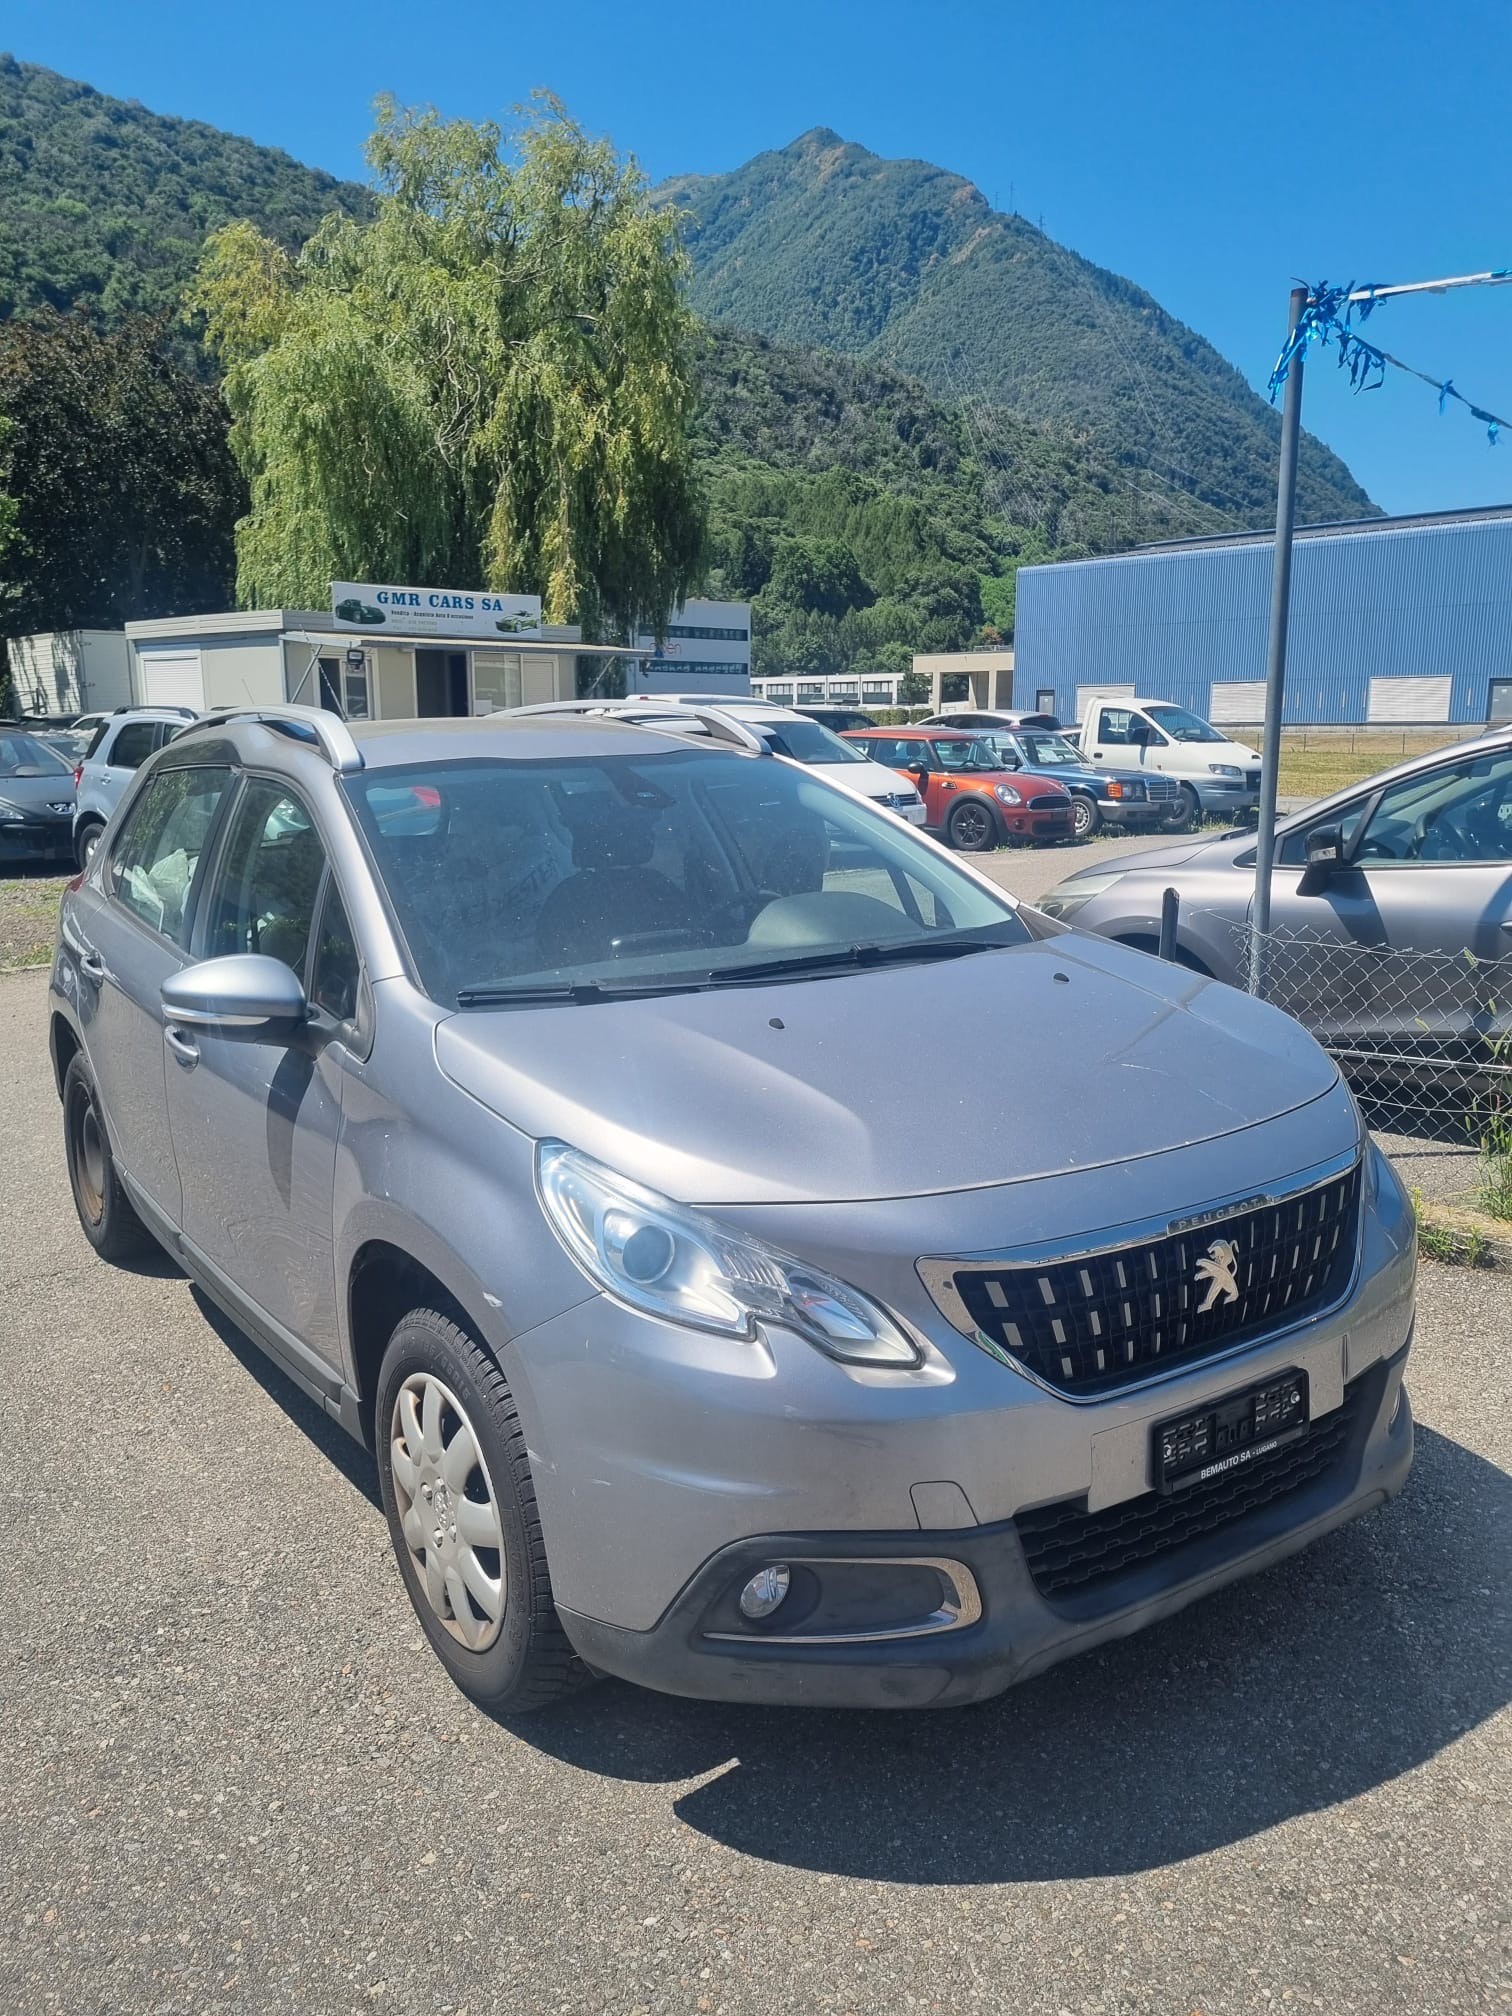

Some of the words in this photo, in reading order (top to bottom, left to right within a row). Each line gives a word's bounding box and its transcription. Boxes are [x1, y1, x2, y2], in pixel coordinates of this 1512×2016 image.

[377, 591, 421, 607] GMR
[428, 594, 474, 610] CARS
[481, 598, 503, 611] SA
[1178, 1198, 1260, 1230] PEUGEOT
[1200, 1455, 1239, 1480] BEMAUTO
[1240, 1450, 1251, 1462] SA
[1256, 1440, 1278, 1456] LUGANO
